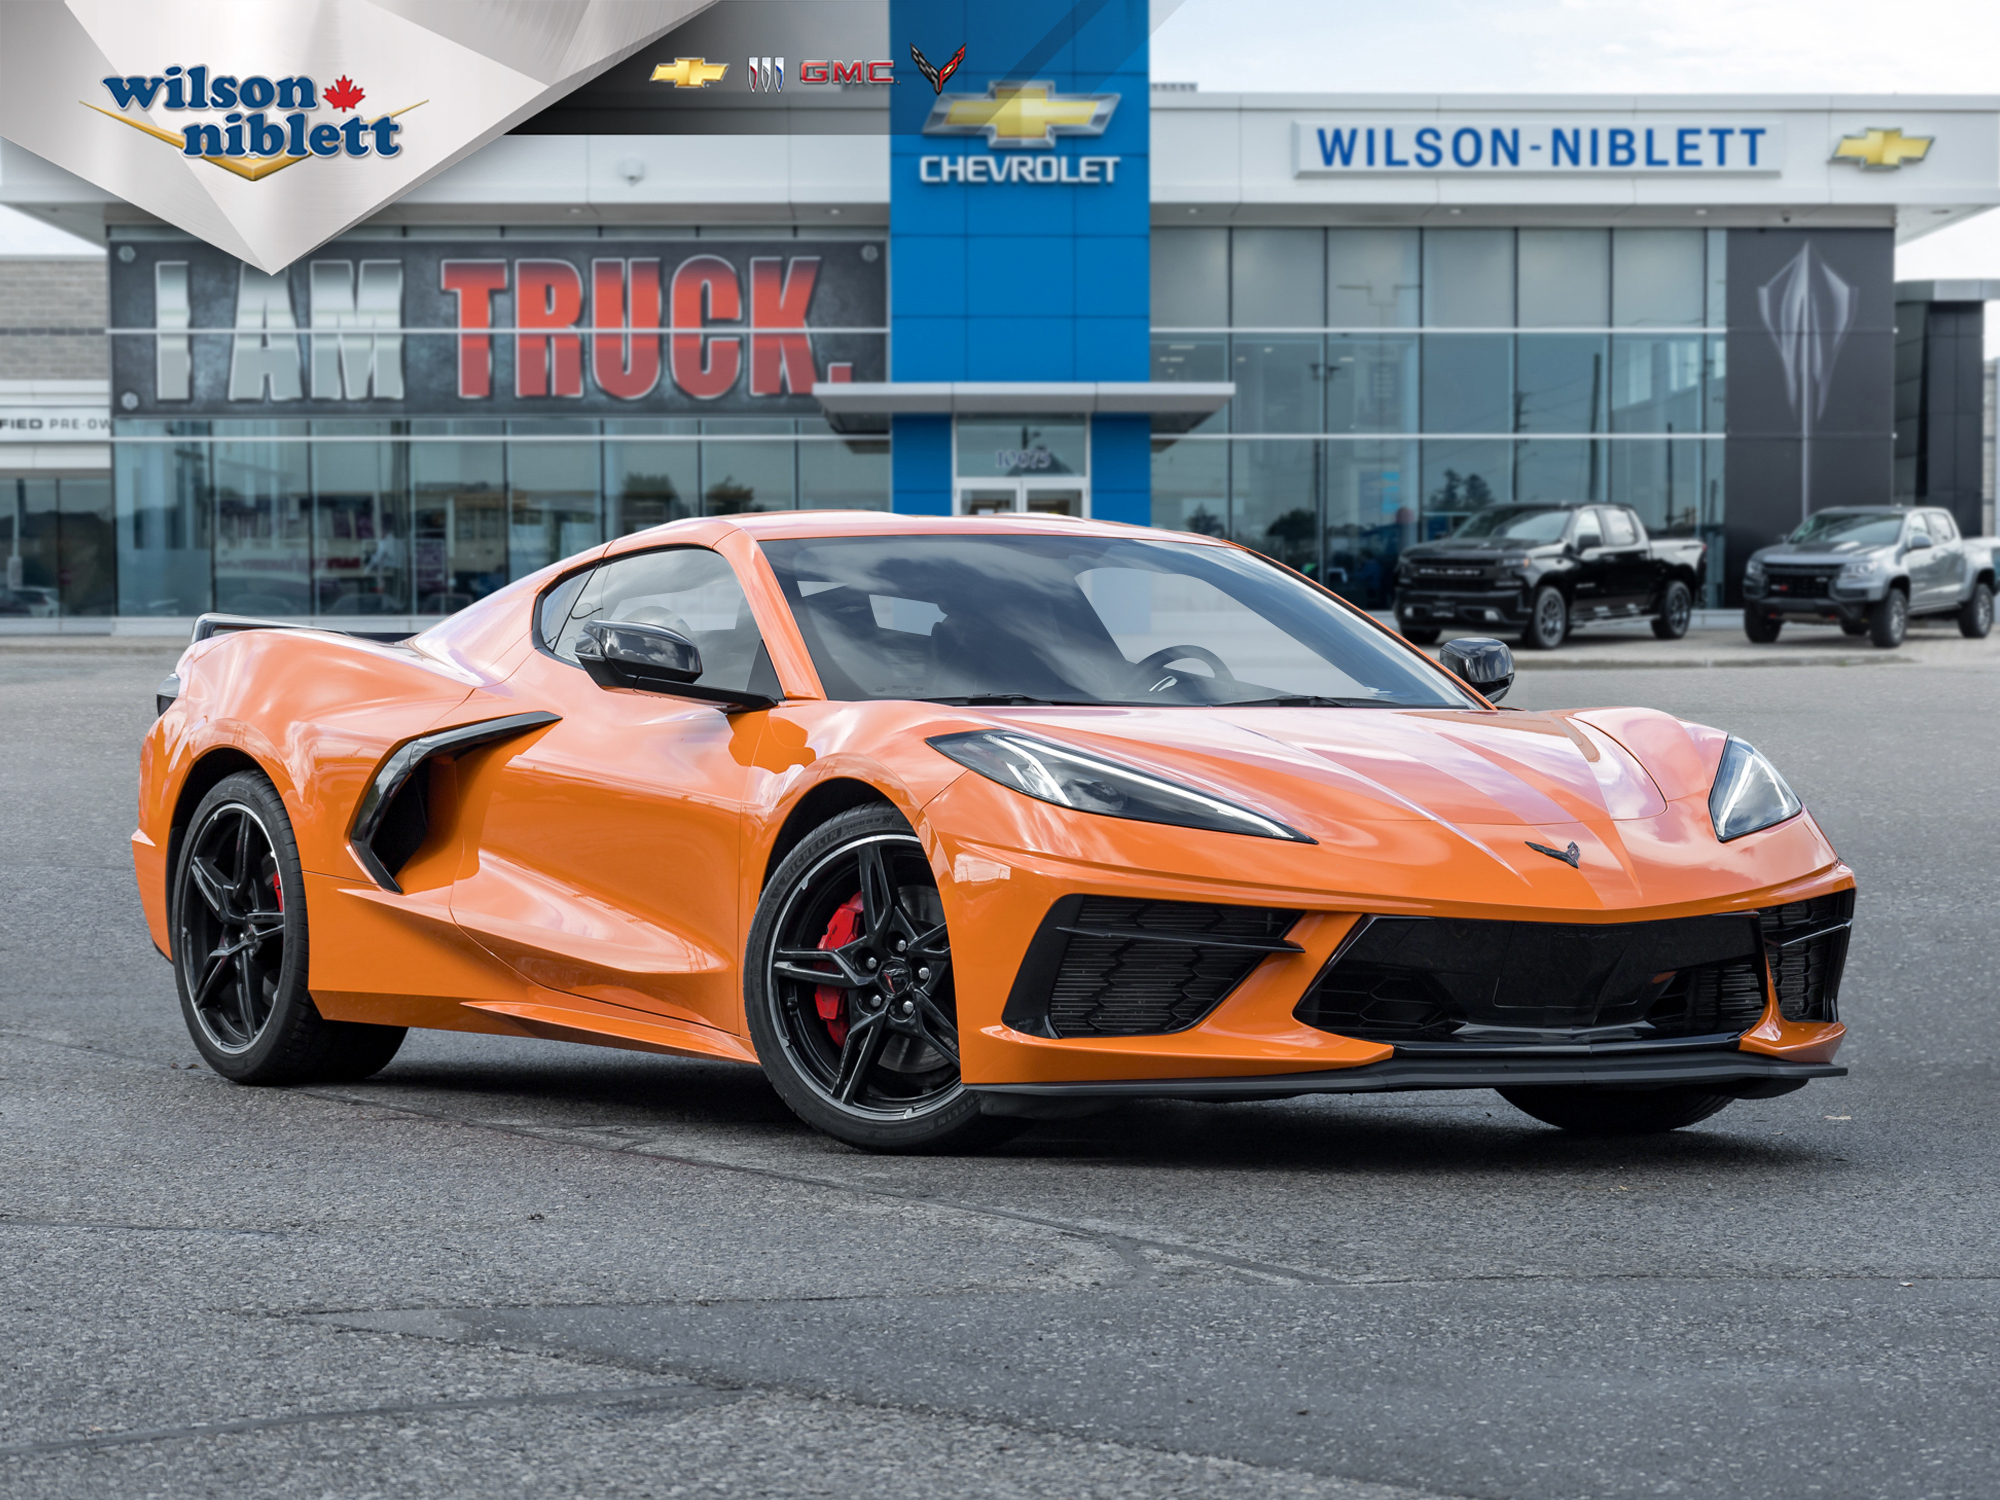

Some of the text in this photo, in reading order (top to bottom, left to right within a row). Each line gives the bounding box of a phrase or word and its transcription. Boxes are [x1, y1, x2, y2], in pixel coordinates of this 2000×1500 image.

[919, 155, 1121, 183] CHEVROLET
[1316, 127, 1767, 168] WILSON-NIBLETT
[155, 254, 854, 401] I AM TRUCK.
[783, 829, 840, 881] MICHELIN
